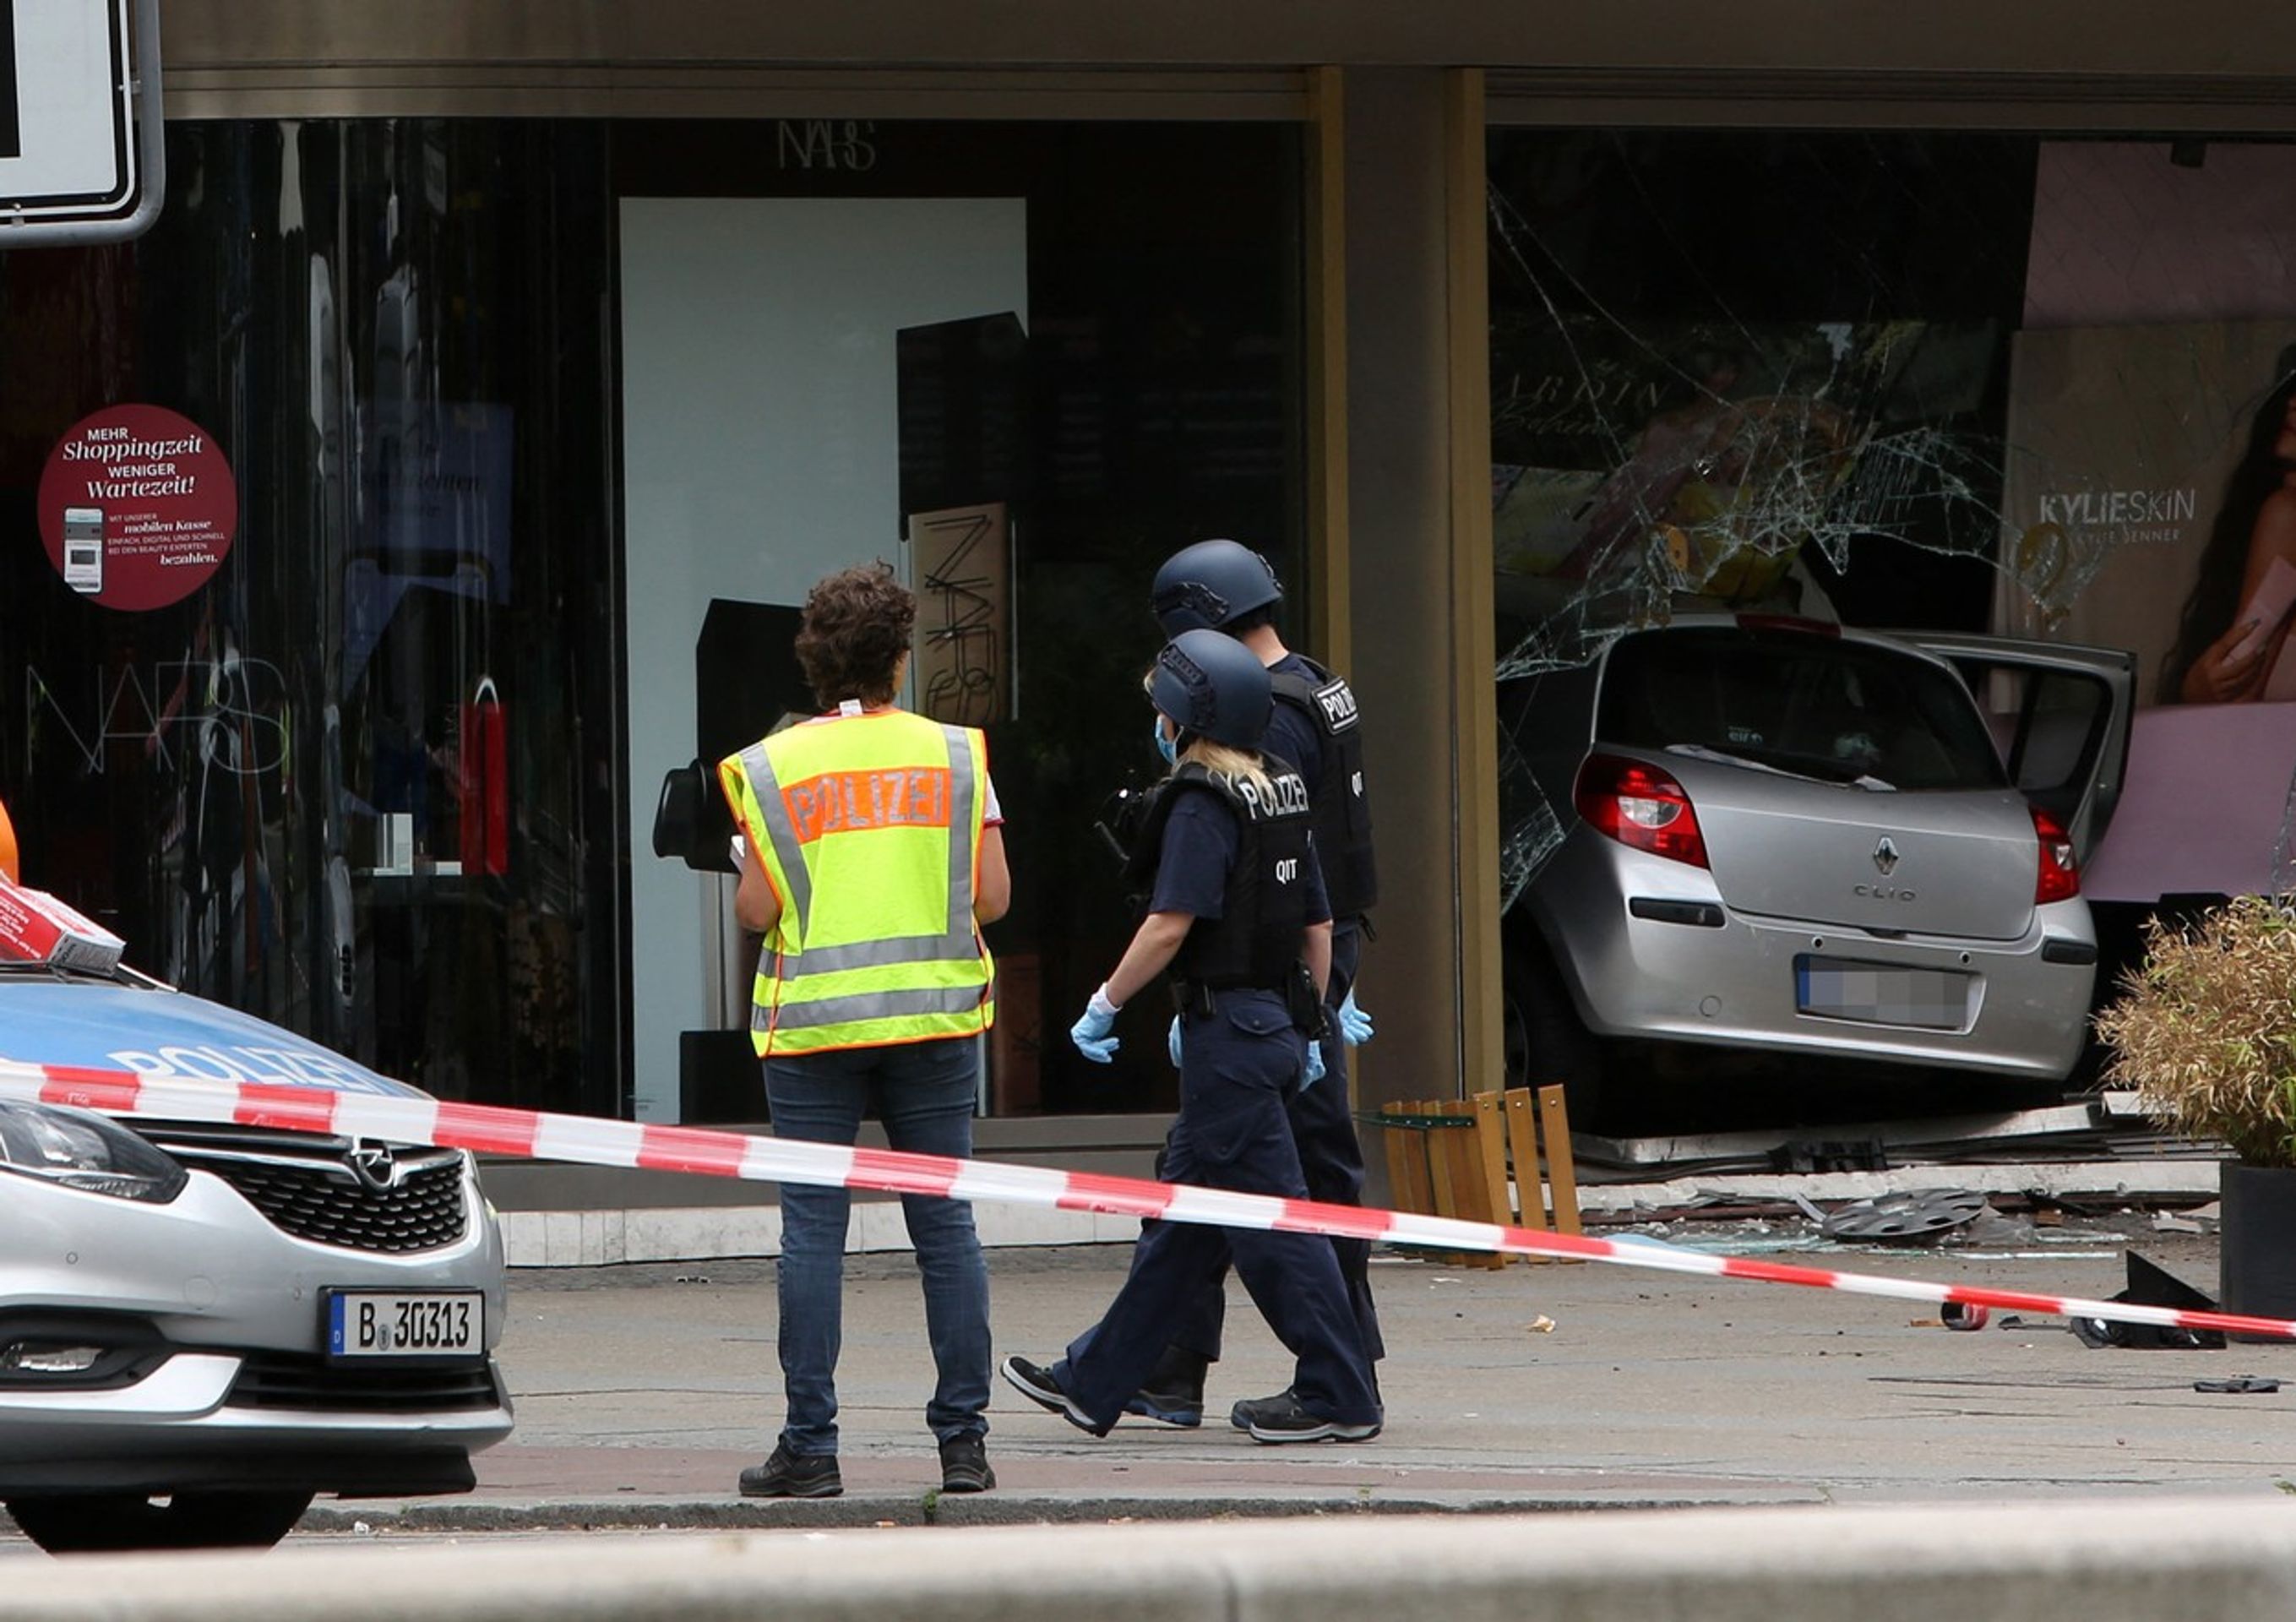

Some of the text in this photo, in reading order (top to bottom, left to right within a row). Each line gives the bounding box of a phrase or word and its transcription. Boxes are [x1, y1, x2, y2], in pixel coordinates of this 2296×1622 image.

[87, 427, 128, 441] MEHR
[63, 435, 203, 463] Shoppingzeit
[107, 463, 176, 478] WENIGER
[87, 476, 194, 498] Wartezeit!
[123, 513, 157, 521] UNSERER
[124, 520, 211, 534] mobilen Kasse
[172, 533, 190, 542] UND
[192, 532, 225, 542] SCHNELL
[122, 546, 137, 554] DEN
[160, 552, 218, 565] bezahlen.
[27, 658, 289, 776] NARS
[792, 770, 943, 838] POLIZEI
[1238, 773, 1309, 819] POLIZEI
[1276, 858, 1298, 884] QIT
[1853, 885, 1917, 901] CLIO
[359, 1302, 376, 1347] B
[394, 1302, 470, 1347] 30313
